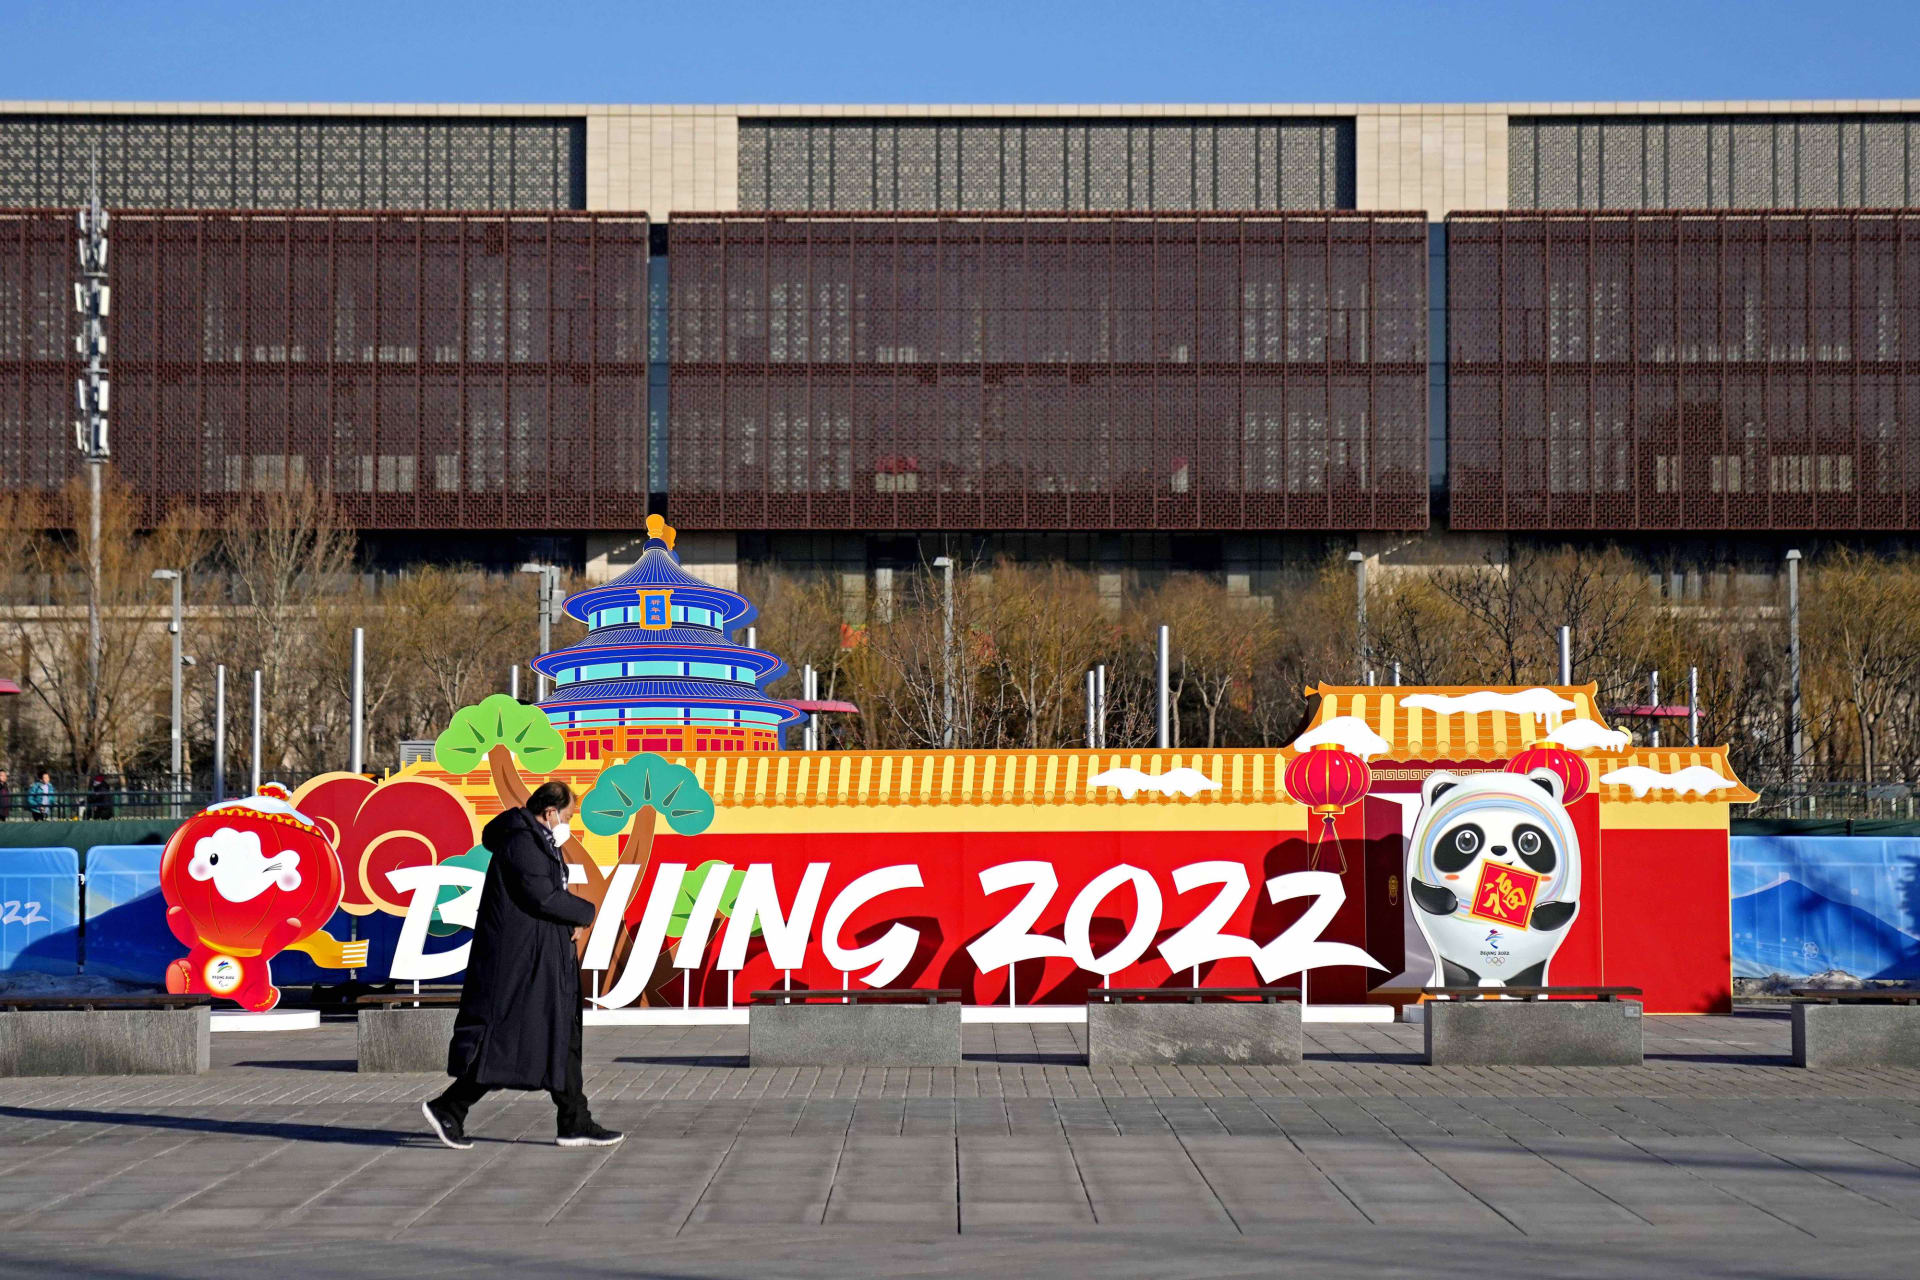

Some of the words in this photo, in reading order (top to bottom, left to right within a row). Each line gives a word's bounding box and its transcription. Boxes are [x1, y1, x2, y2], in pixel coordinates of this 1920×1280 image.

[0, 900, 49, 926] 22
[1483, 872, 1527, 918] 福
[385, 862, 924, 1010] BIJING
[966, 860, 1391, 985] 2022
